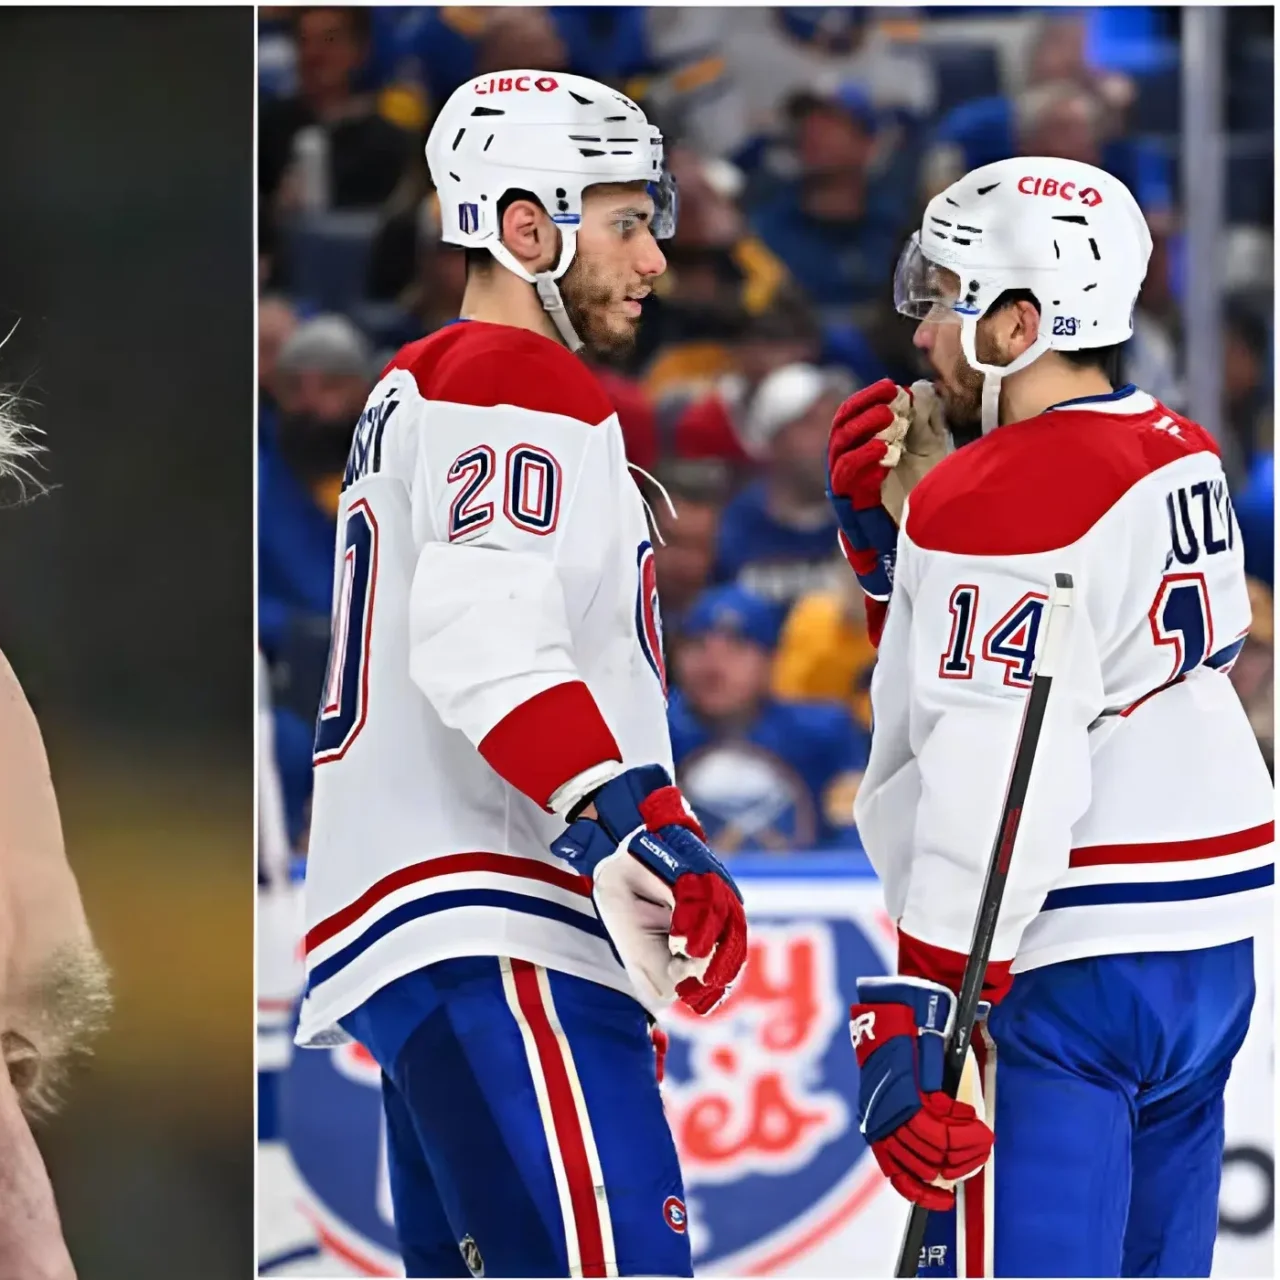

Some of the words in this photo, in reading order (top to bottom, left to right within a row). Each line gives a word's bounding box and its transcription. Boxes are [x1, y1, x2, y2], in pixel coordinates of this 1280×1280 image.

[1017, 175, 1076, 201] CIBC
[447, 442, 562, 543] 20
[938, 584, 1049, 689] 14
